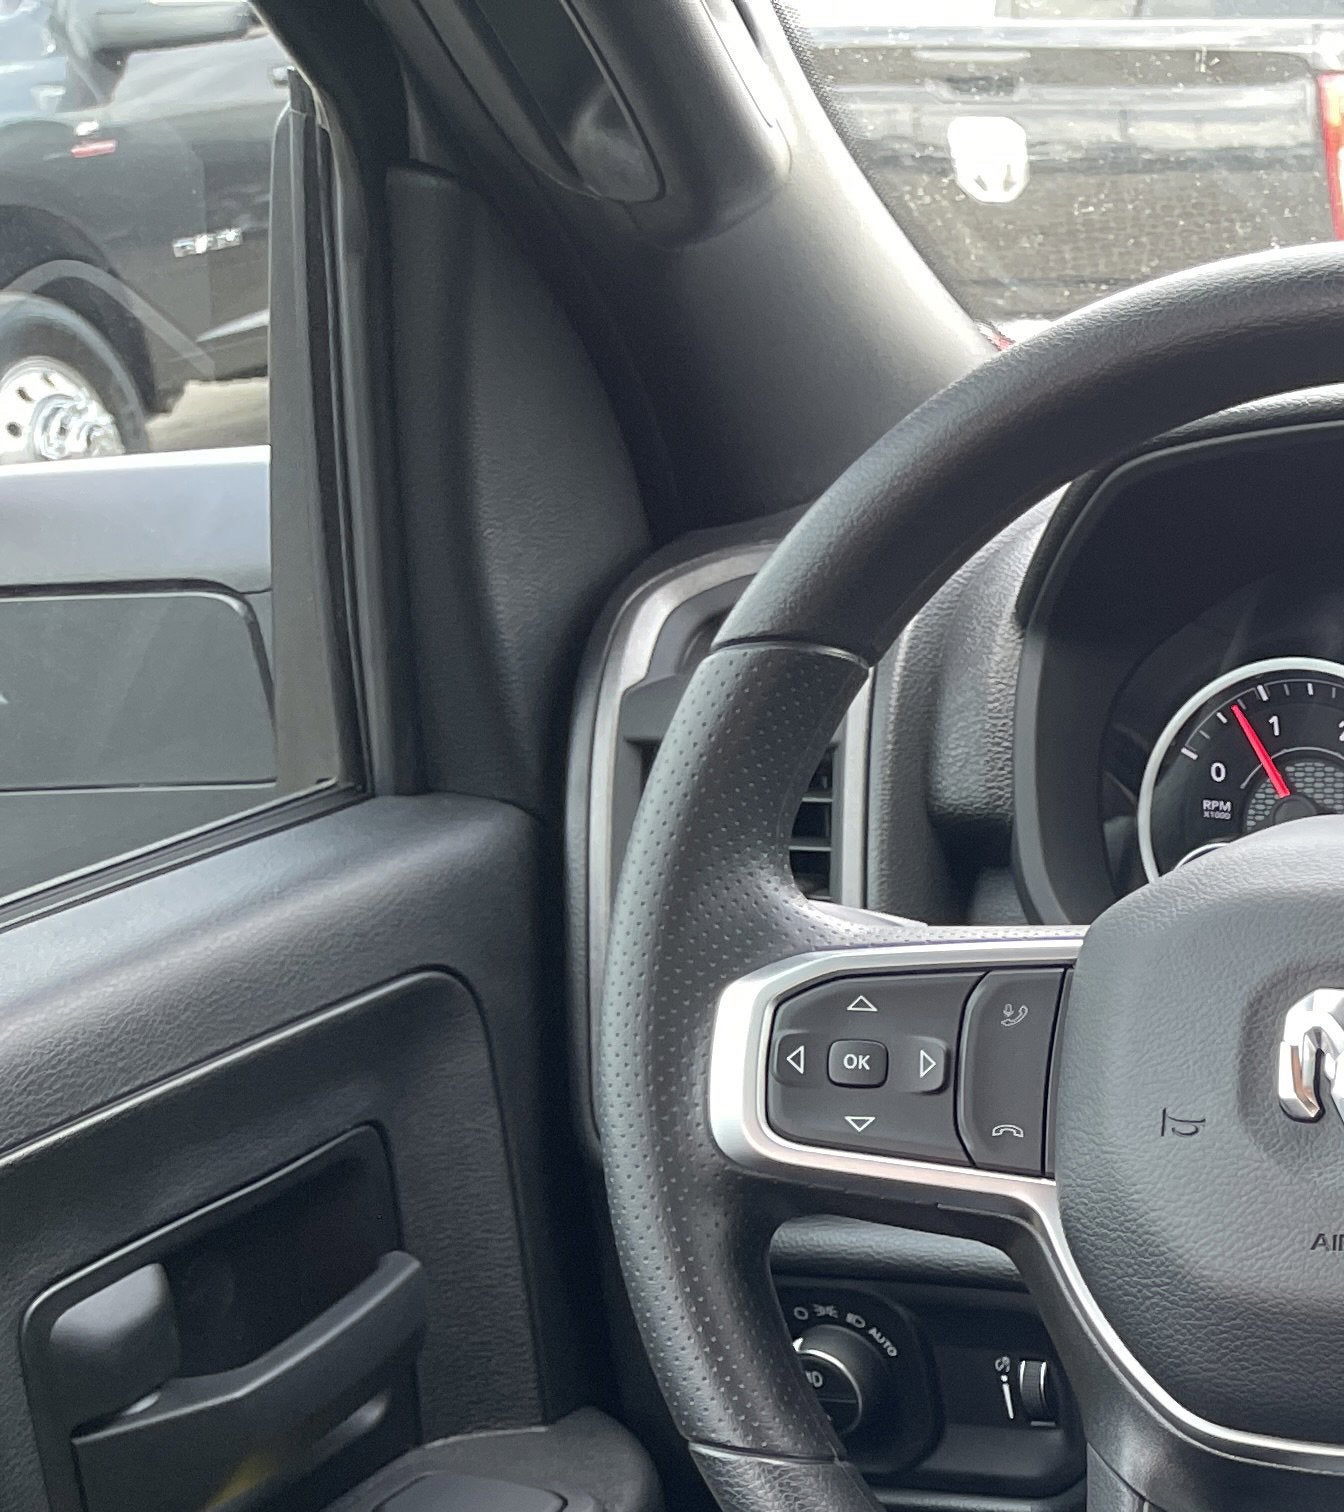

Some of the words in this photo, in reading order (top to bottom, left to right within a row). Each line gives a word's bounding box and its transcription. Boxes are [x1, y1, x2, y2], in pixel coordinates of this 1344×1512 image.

[1268, 716, 1280, 736] 1
[1210, 762, 1226, 782] 0
[1202, 799, 1232, 812] RPM
[842, 1053, 871, 1071] OK
[868, 1327, 899, 1357] AUTO
